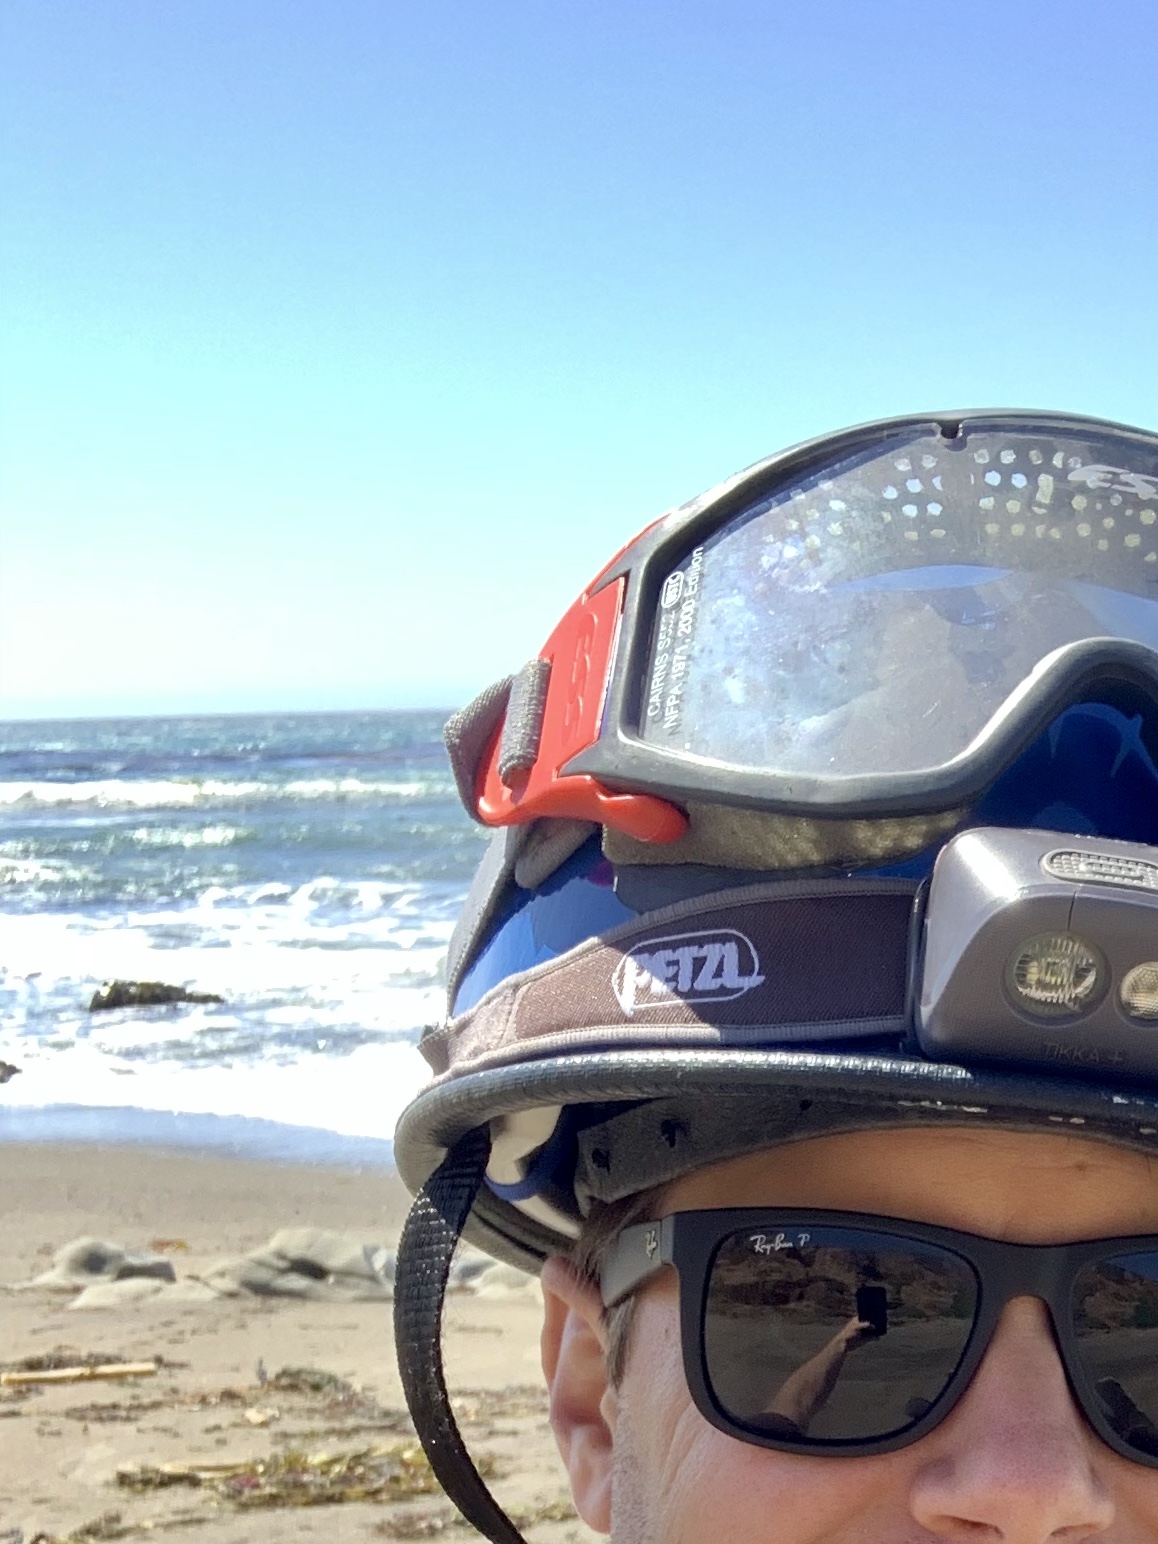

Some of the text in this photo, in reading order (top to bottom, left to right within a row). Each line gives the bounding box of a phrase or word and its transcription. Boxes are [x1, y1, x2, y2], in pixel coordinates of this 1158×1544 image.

[684, 546, 704, 597] Edition
[677, 599, 696, 637] 2000
[647, 652, 669, 717] CAIRNS
[662, 682, 683, 729] NFPA
[621, 940, 765, 1016] PETZL
[1042, 1041, 1100, 1064] TIKKA
[750, 1233, 793, 1255] Ray-Ban
